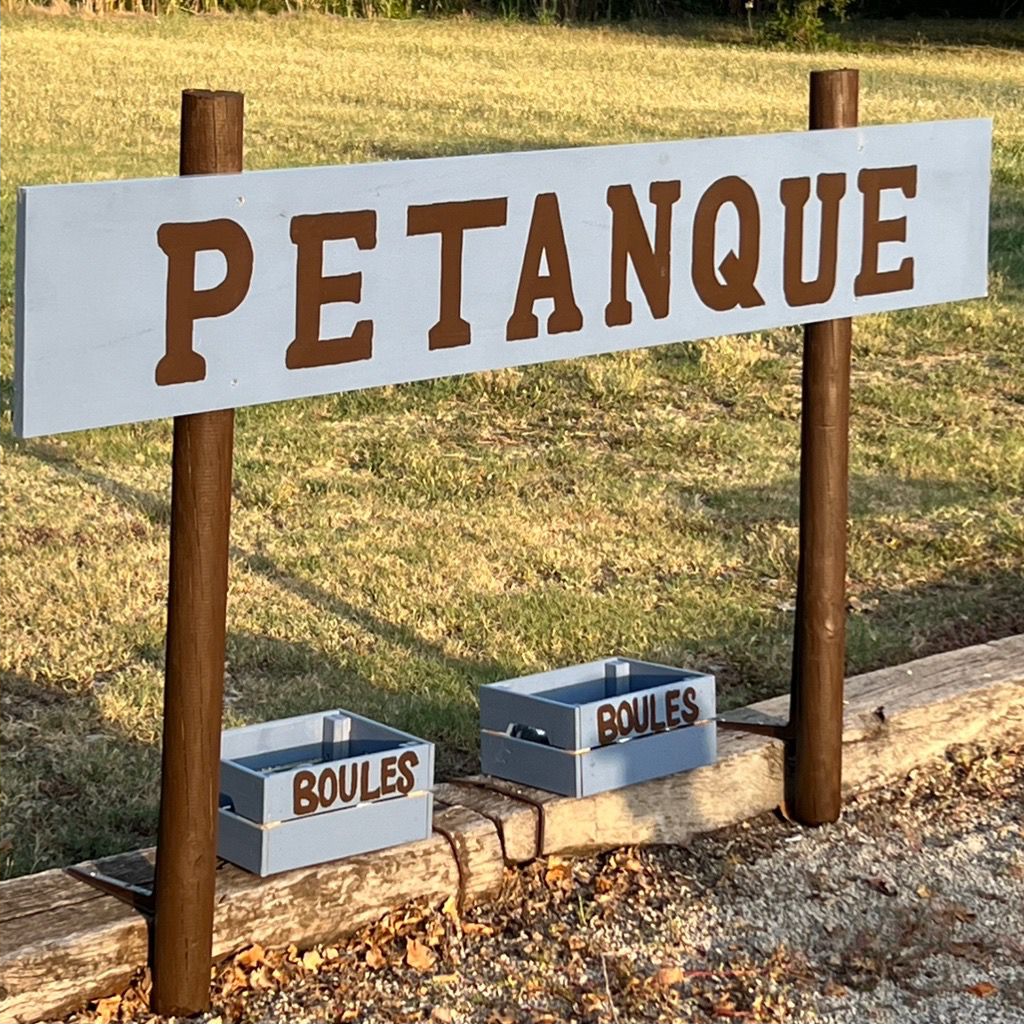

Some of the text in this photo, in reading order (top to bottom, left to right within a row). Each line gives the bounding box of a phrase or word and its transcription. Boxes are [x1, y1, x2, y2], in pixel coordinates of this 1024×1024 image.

[154, 164, 918, 386] PETANQUE
[597, 686, 700, 746] BOULES
[292, 751, 420, 816] BOULES
